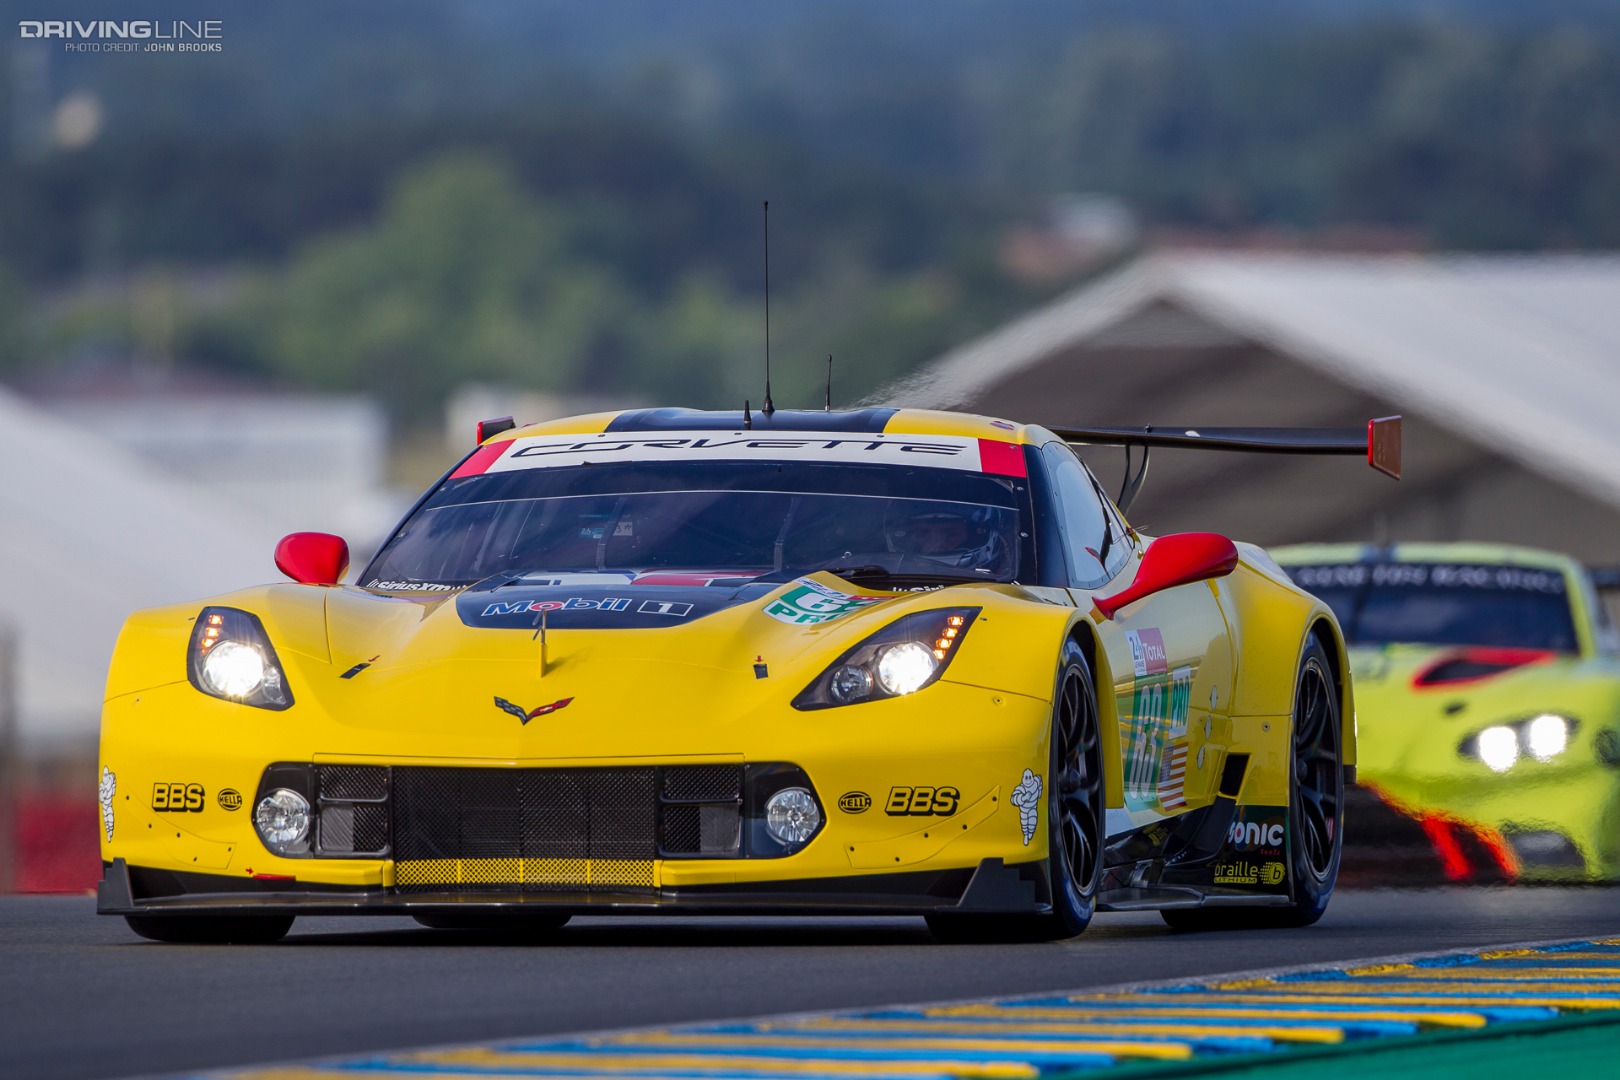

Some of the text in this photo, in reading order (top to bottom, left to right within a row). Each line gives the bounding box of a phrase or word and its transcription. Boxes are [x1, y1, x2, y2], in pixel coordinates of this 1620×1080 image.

[510, 438, 968, 458] CORVETTE
[481, 597, 633, 616] Mobil
[1142, 643, 1166, 661] TOTAL
[1170, 676, 1190, 729] PRO
[153, 783, 205, 812] BBS
[885, 786, 961, 816] BBS
[1214, 861, 1258, 877] braille
